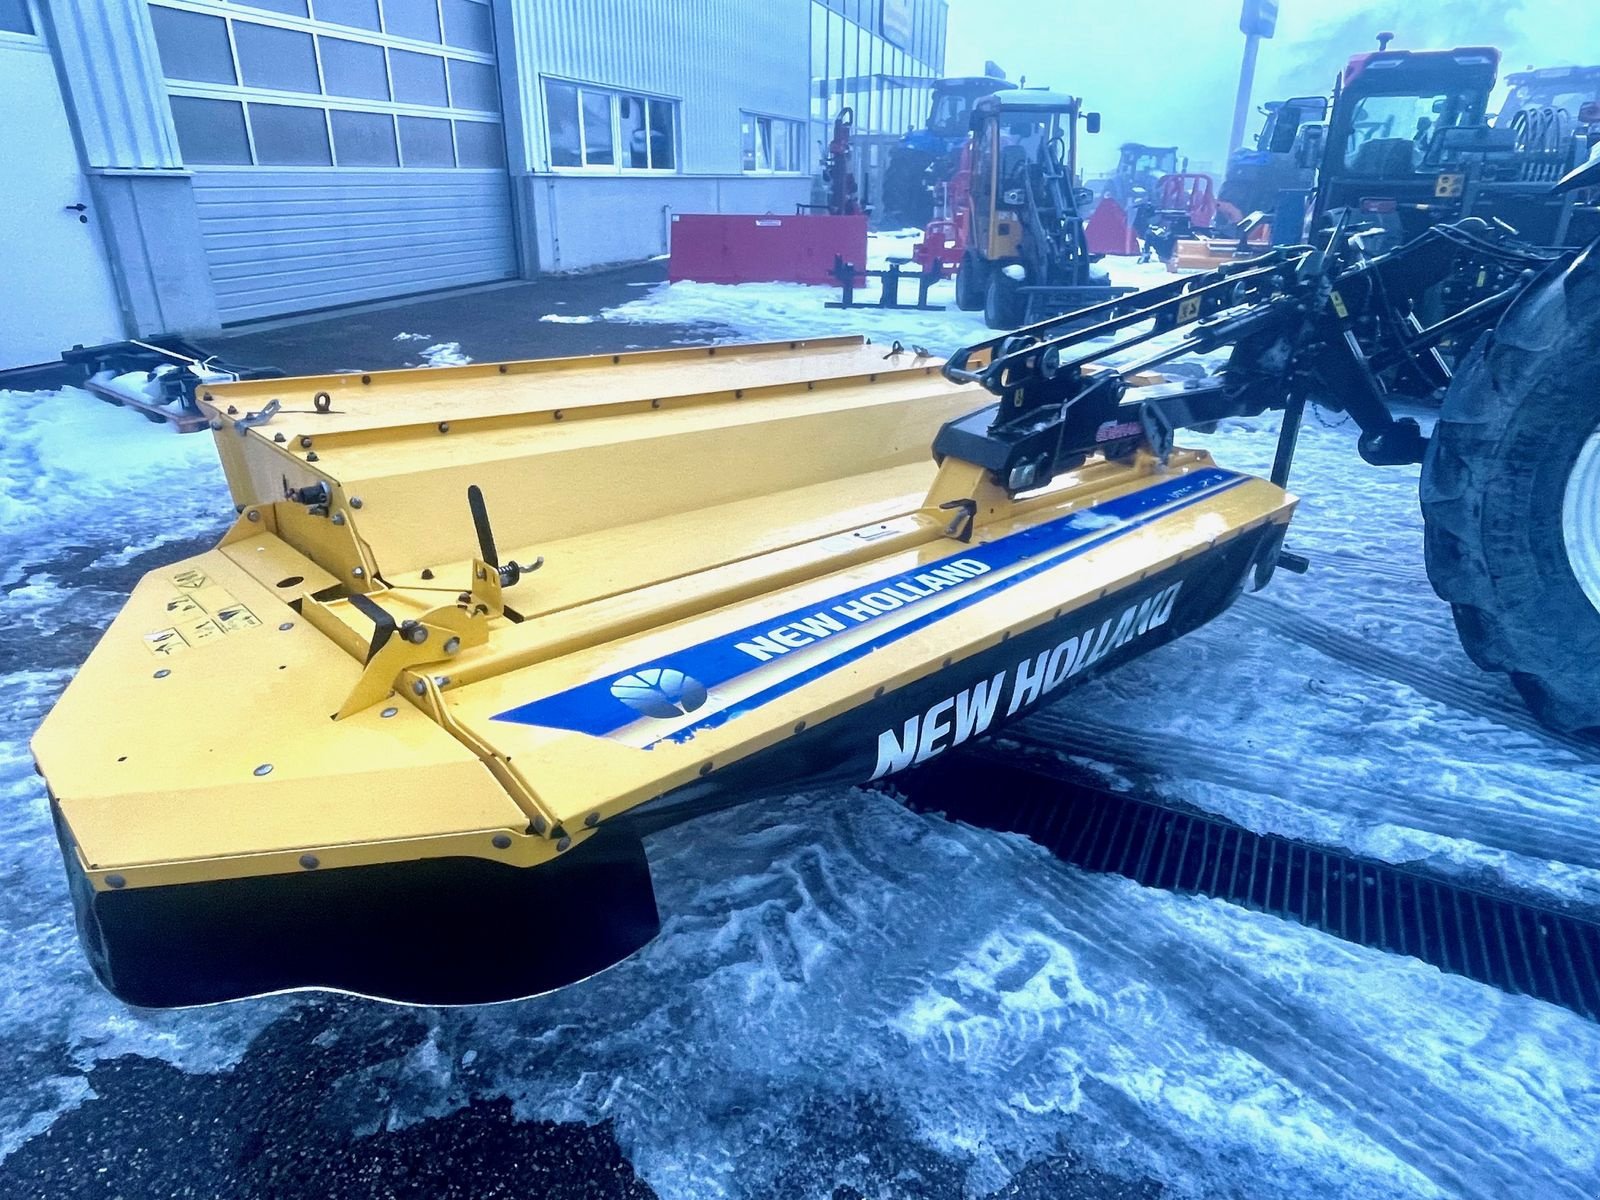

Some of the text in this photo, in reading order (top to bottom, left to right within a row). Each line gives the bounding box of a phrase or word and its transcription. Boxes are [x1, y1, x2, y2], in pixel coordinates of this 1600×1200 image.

[733, 558, 992, 662] NEW HOLLAND
[867, 580, 1184, 782] NEW HOLLAND
